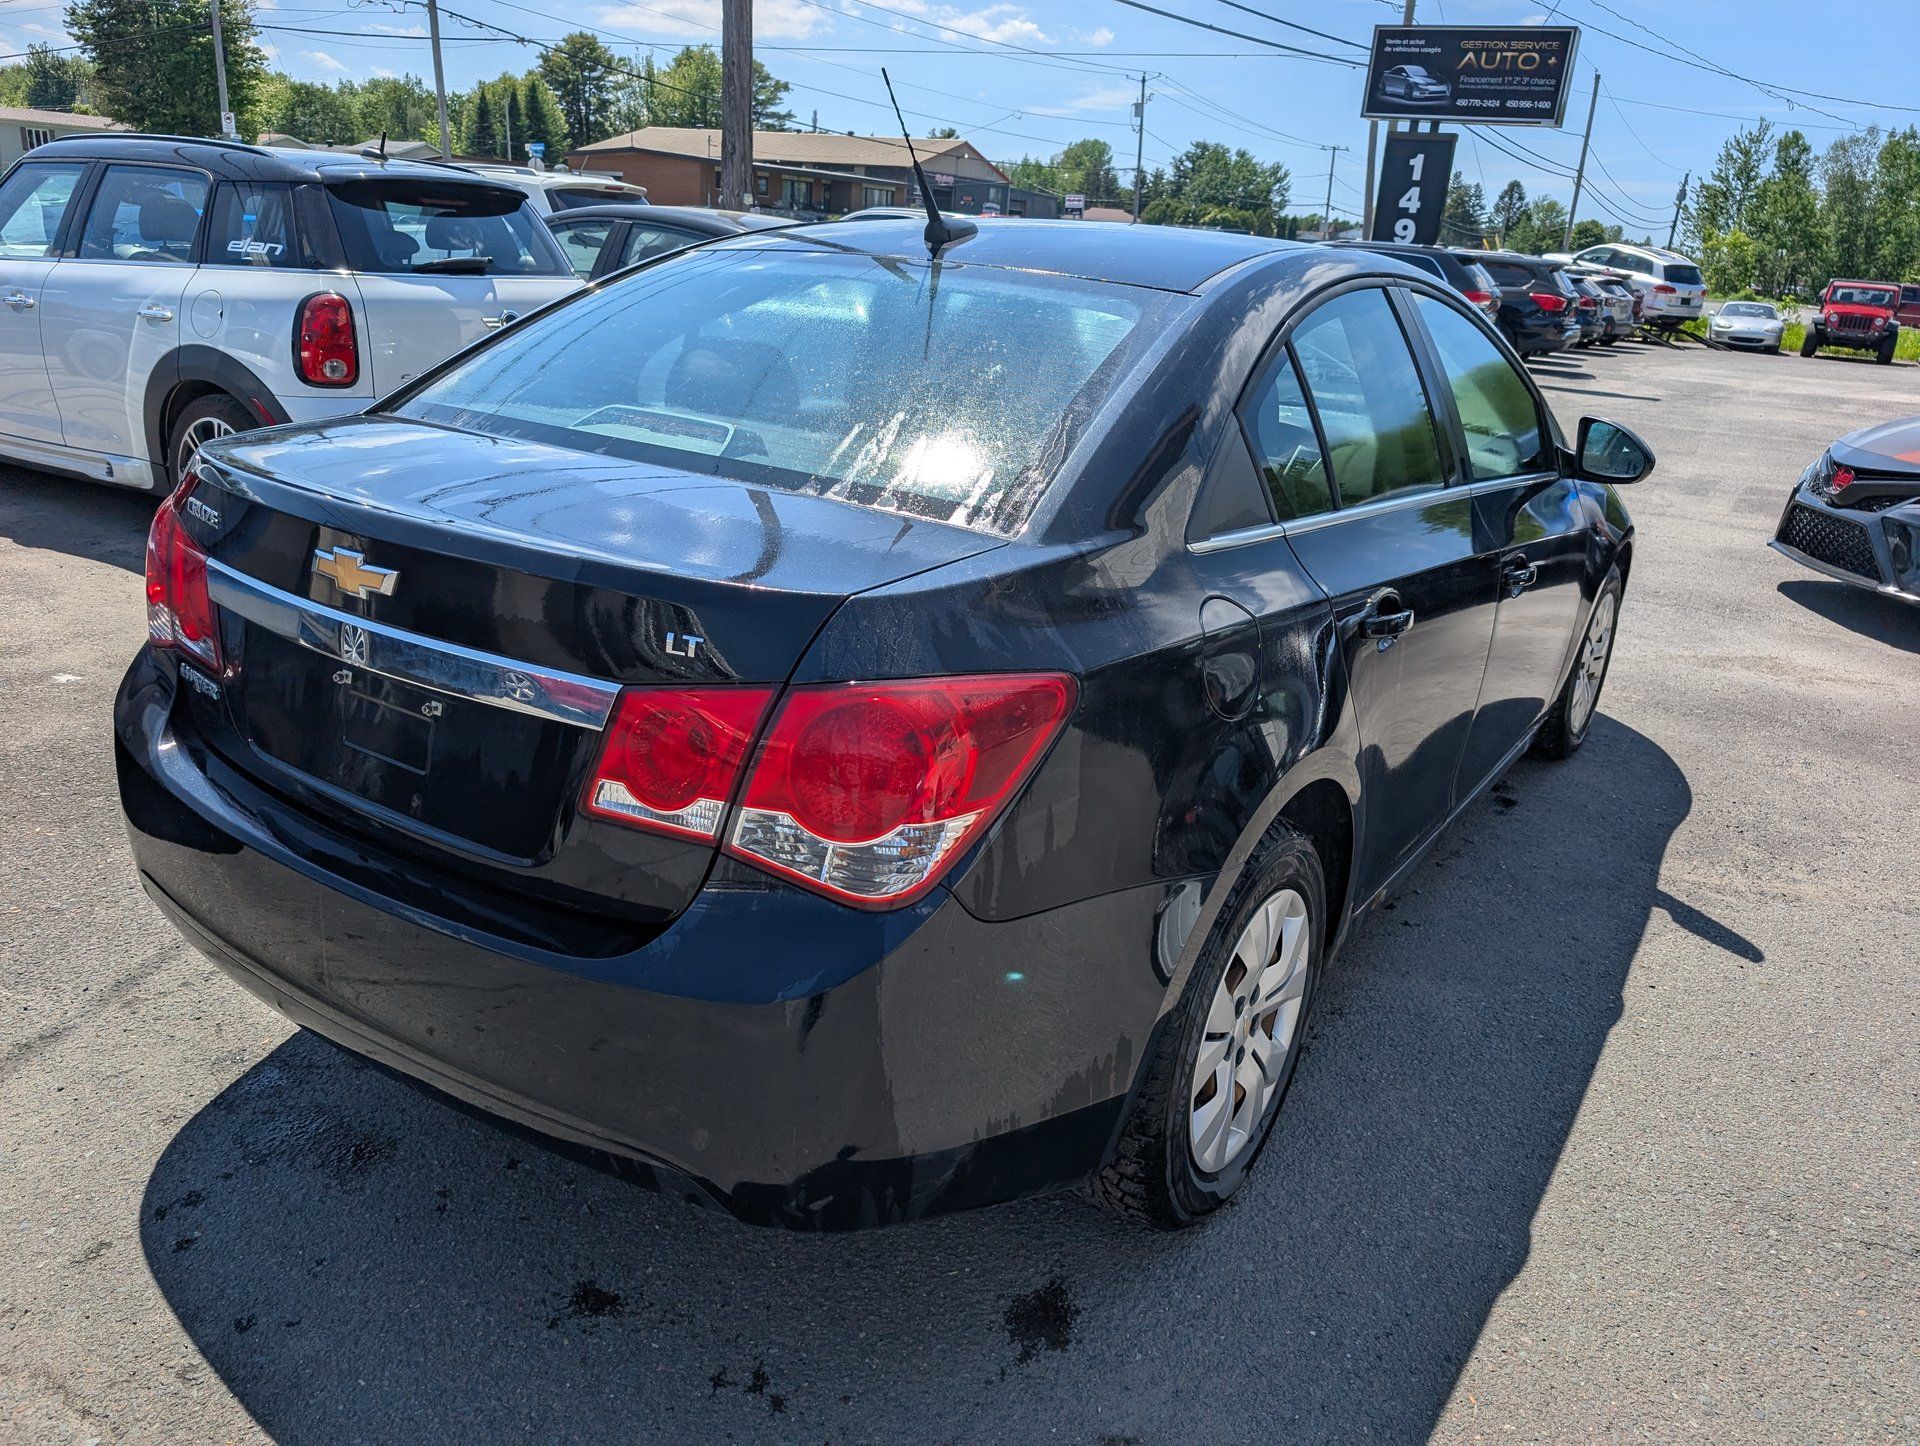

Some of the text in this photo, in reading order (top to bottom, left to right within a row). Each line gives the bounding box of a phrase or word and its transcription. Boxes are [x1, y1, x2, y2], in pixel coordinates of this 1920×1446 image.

[1460, 40, 1560, 50] GESTION SERVICE
[1457, 51, 1540, 70] AUTO
[1460, 75, 1502, 83] Financement
[1531, 77, 1556, 85] chance
[1469, 99, 1500, 107] 770-2424
[1519, 100, 1551, 109] 956-1400
[227, 237, 283, 256] elan
[665, 632, 704, 658] LT
